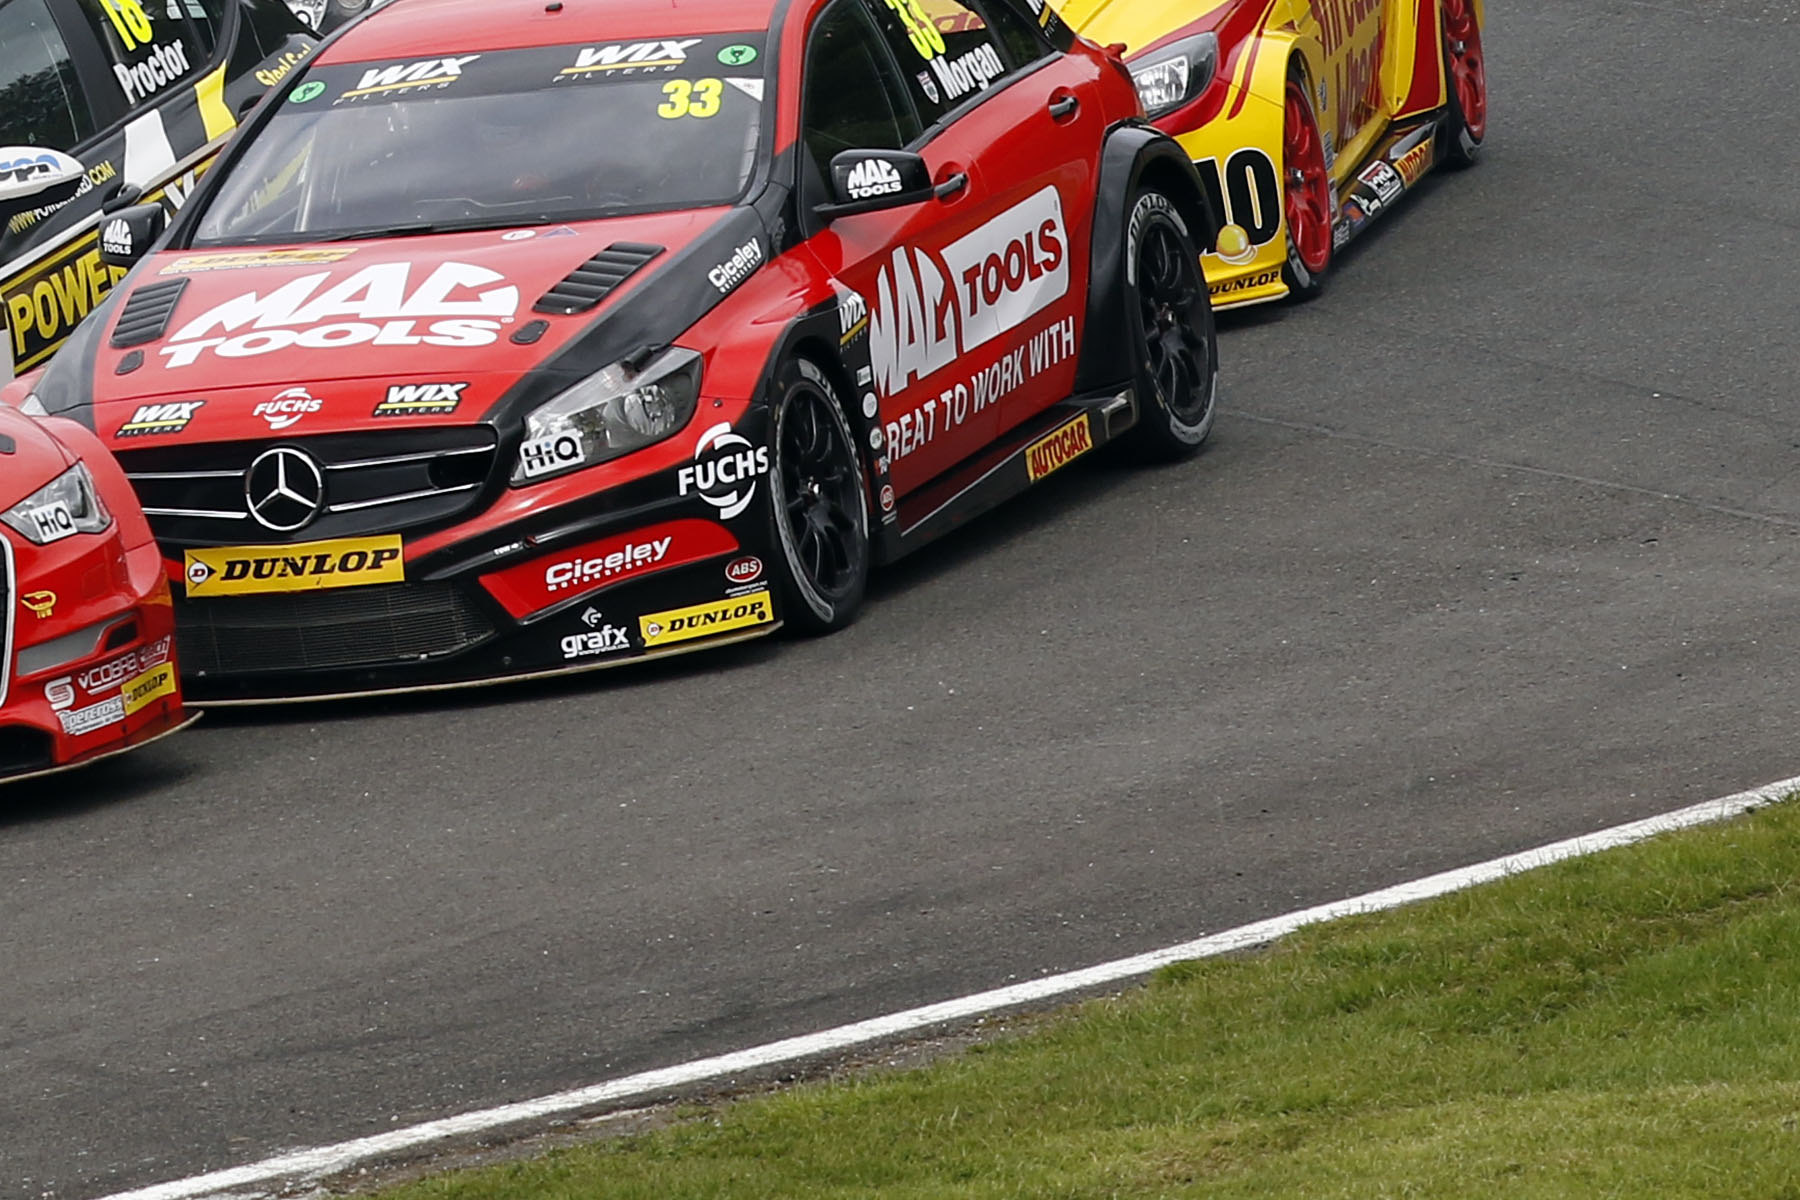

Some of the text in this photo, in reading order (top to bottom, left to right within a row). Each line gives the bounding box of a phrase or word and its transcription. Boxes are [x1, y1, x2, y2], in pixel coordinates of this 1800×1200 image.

[574, 38, 702, 68] WIX
[113, 38, 191, 105] Proctor
[357, 55, 481, 87] WIX
[552, 64, 678, 83] FILTERS
[930, 42, 1004, 100] Morgan
[657, 79, 723, 119] 33
[847, 159, 900, 189] MAC
[848, 181, 902, 199] TOOLS
[103, 218, 132, 245] MAC
[103, 243, 131, 255] TOOLS
[708, 236, 762, 289] Ciceley
[168, 262, 519, 343] MAC
[840, 292, 867, 334] WIX
[869, 218, 1063, 398] MAC TOOLS
[159, 319, 502, 369] TOOLS
[386, 383, 469, 403] WIX
[886, 316, 1076, 464] REAT TO WORK WITH
[131, 401, 203, 424] WIX
[252, 397, 324, 417] FUCHS
[373, 405, 454, 418] FILTERS
[115, 424, 183, 438] FILTERS
[524, 436, 580, 470] HiQ
[1029, 420, 1091, 479] AUTOCAR
[678, 446, 769, 496] FUCHS
[38, 506, 73, 536] HiQ
[221, 548, 399, 581] DUNLOP
[546, 536, 672, 585] Ciceley
[548, 556, 653, 591] MOTORSPORT
[731, 559, 758, 577] ABS
[668, 601, 764, 633] DUNLOP
[561, 623, 628, 659] grafx
[132, 672, 168, 700] DUNLOP
